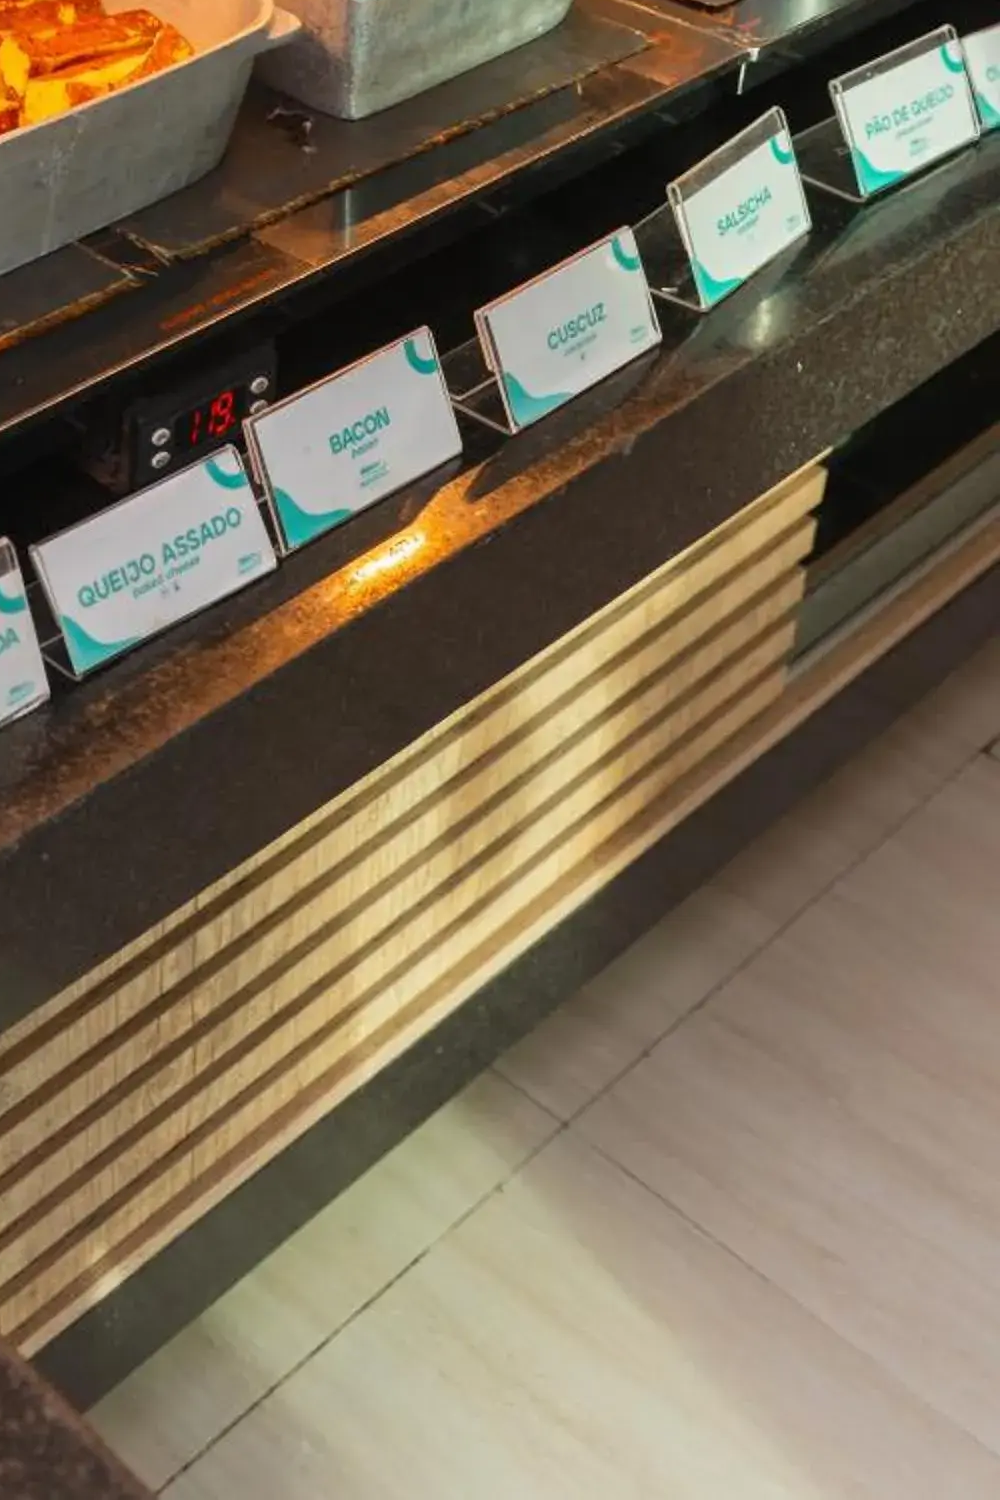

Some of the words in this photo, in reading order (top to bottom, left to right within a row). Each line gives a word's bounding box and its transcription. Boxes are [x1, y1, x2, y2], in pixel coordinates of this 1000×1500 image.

[865, 113, 891, 140] PÃO
[891, 105, 909, 127] DE
[716, 185, 773, 236] SALSICHA
[547, 302, 607, 350] CUSCUZ
[328, 406, 391, 454] BACON
[77, 553, 156, 608] QUEIJO
[162, 507, 242, 565] ASSADO
